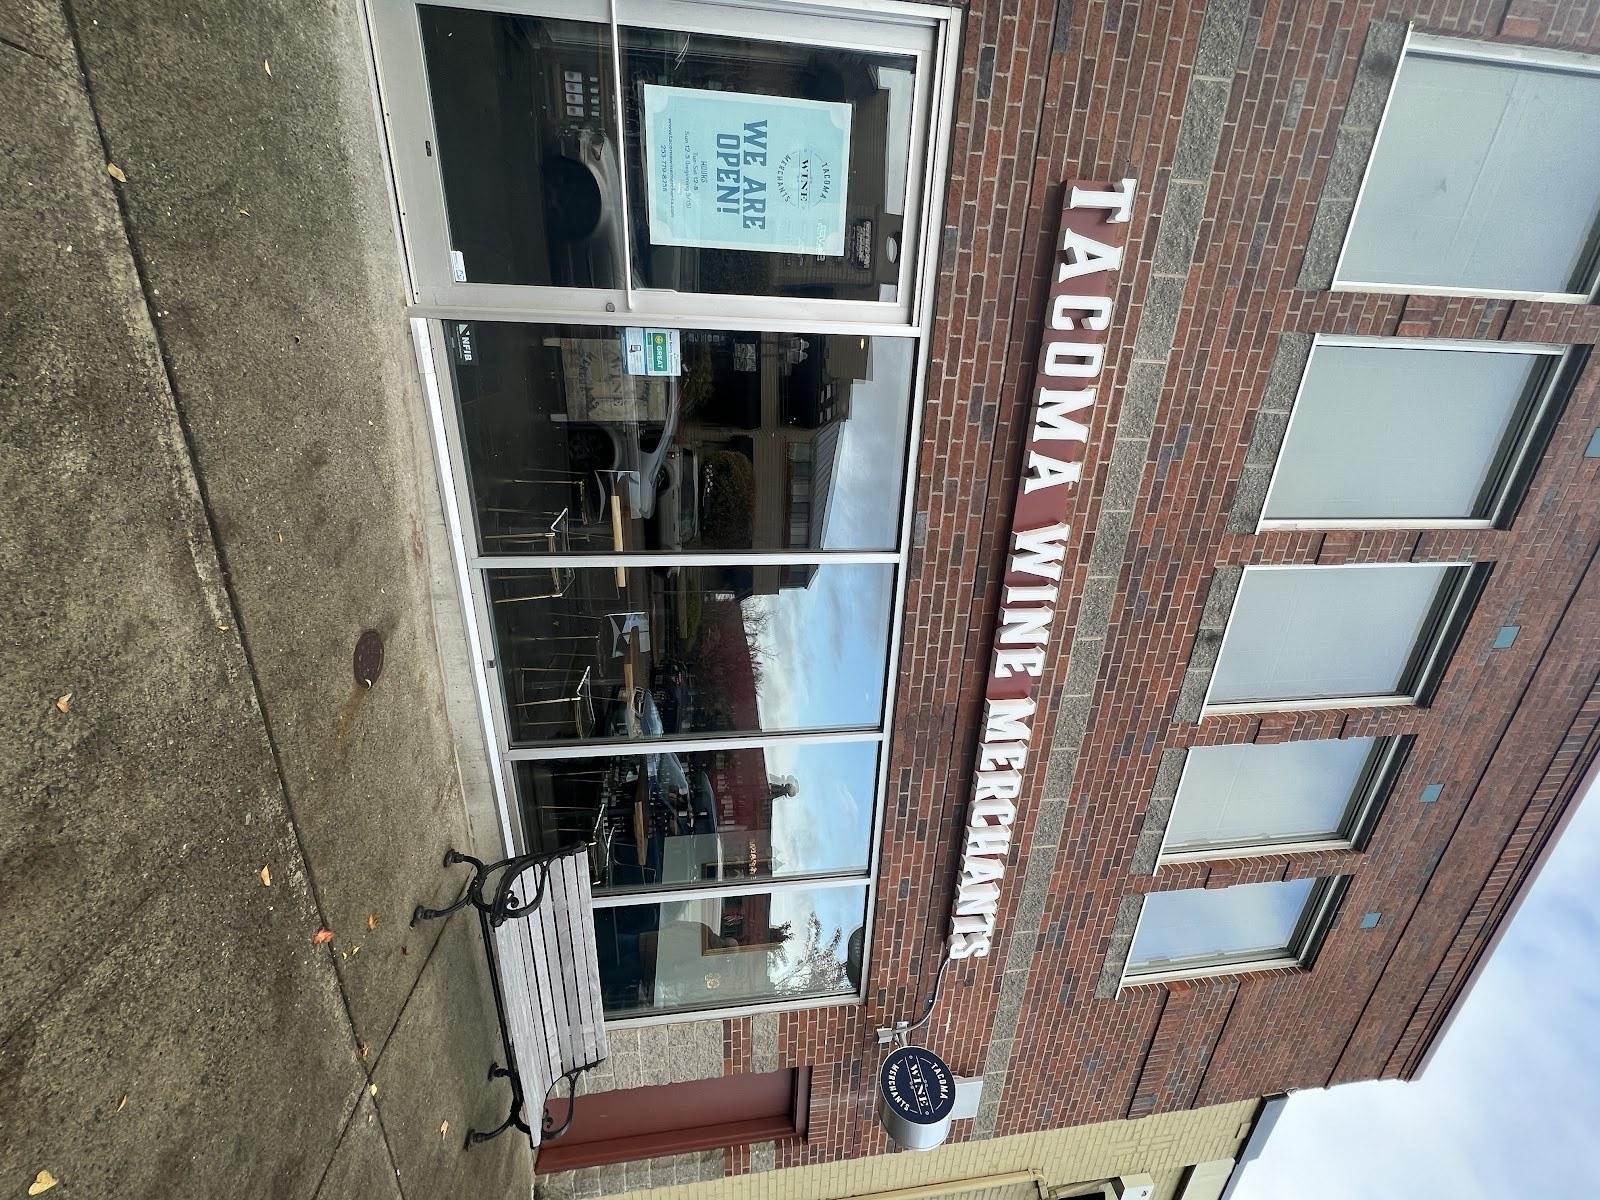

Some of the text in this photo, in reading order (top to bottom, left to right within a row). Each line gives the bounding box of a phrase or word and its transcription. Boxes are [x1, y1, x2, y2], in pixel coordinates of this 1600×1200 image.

[700, 161, 708, 184] HOURS
[716, 134, 741, 215] OPEN!
[742, 119, 768, 230] WE ARE
[777, 154, 791, 203] MERCHANTS
[800, 159, 809, 203] WINE
[819, 162, 831, 199] TACOMA
[461, 337, 472, 361] NFIB
[656, 345, 664, 369] GREAT
[946, 178, 1137, 960] TACOMA WINE MERCHANTS
[888, 1063, 911, 1112] MERCHANTS
[910, 1063, 928, 1106] WINE
[931, 1062, 948, 1100] TACOMA
